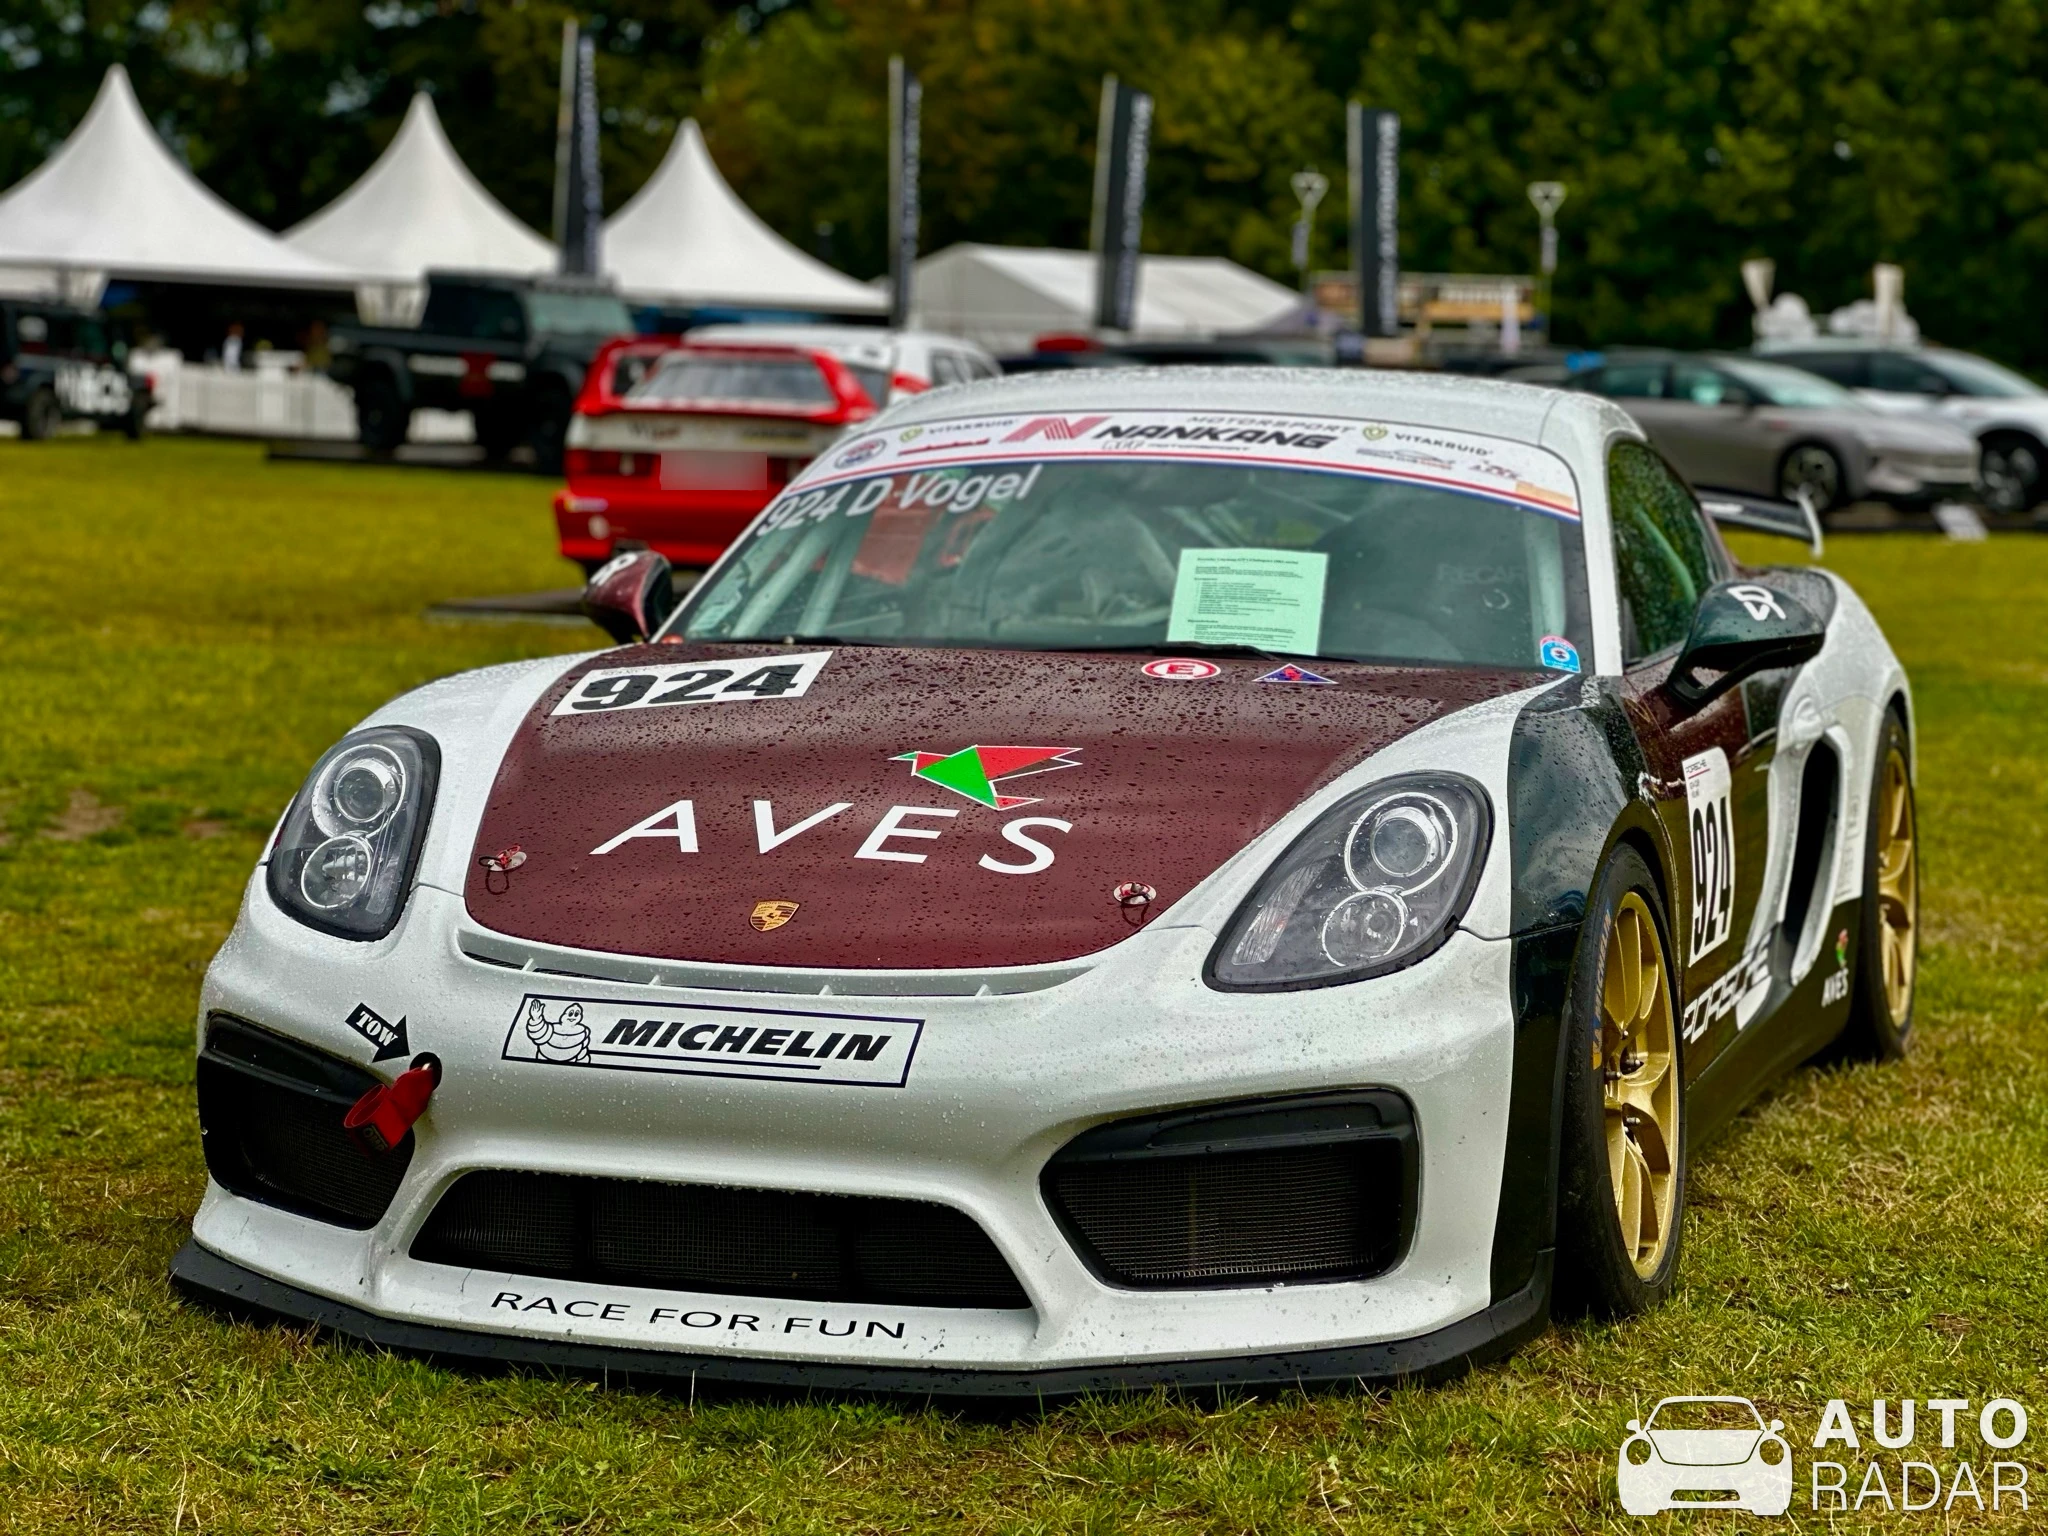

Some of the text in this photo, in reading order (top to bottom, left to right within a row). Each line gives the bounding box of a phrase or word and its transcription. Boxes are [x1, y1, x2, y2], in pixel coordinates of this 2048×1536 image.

[1093, 425, 1340, 449] NANKANG
[1395, 433, 1490, 456] VITAKRUID
[756, 483, 852, 536] 924
[899, 464, 1043, 512] Vogel
[571, 664, 805, 710] 924
[589, 799, 1074, 876] AVES
[1692, 796, 1731, 956] 924
[1594, 908, 1612, 1022] MICHELIN
[356, 1011, 398, 1047] TOW
[602, 1018, 892, 1061] MICHELIN
[490, 1291, 906, 1339] RACE FOR FUN
